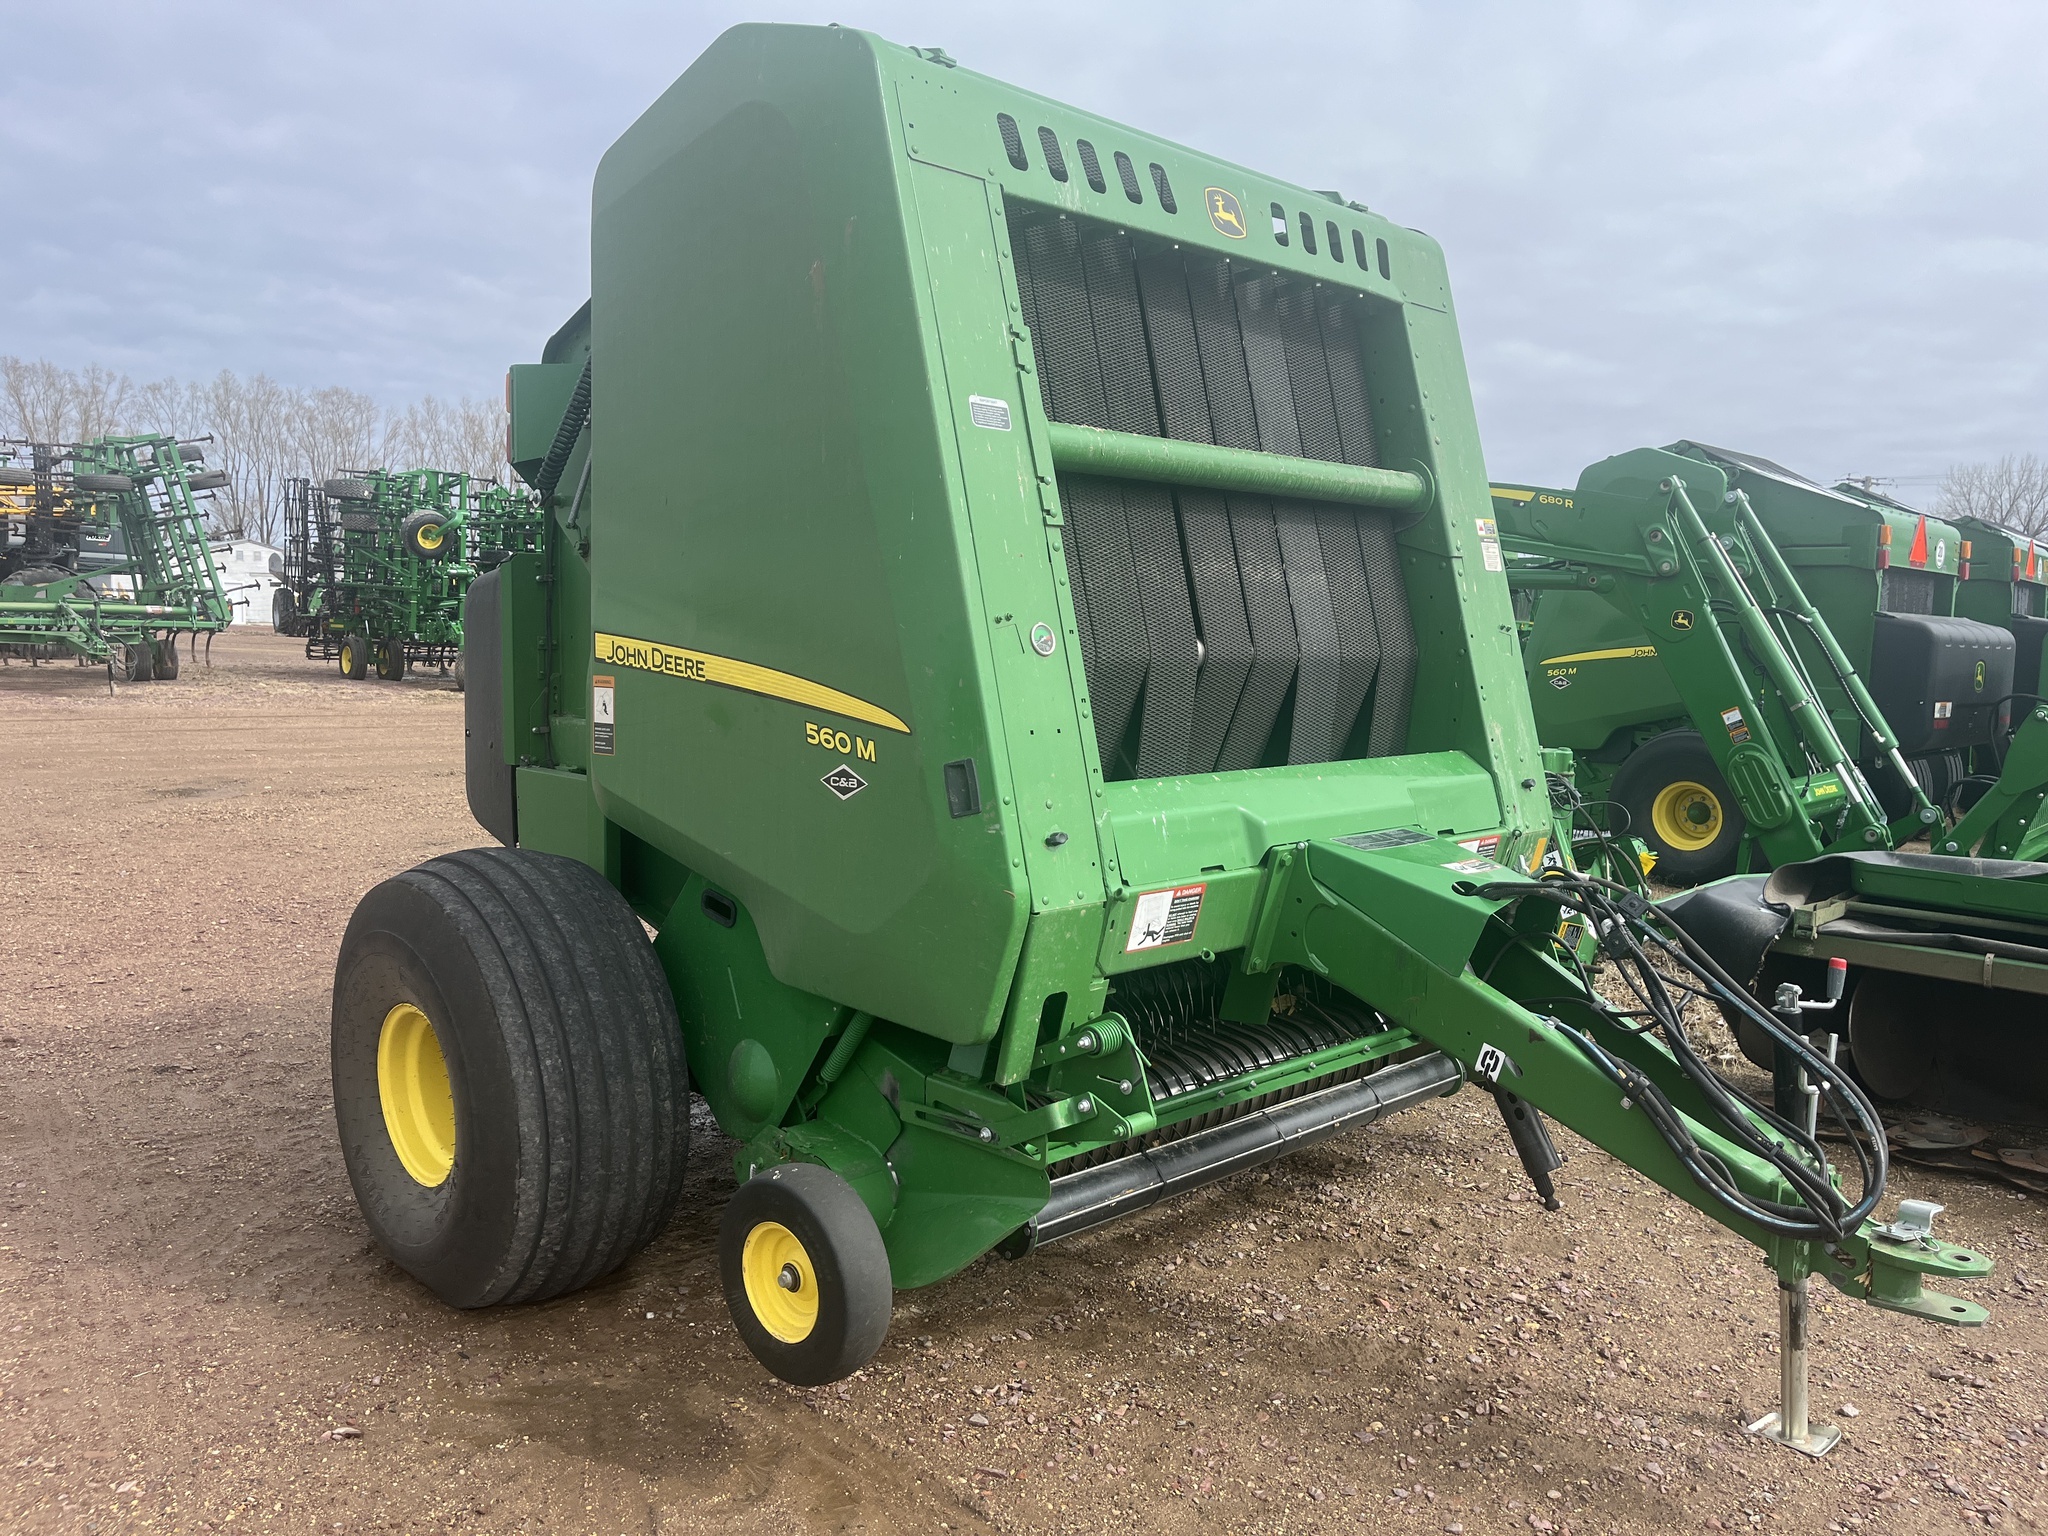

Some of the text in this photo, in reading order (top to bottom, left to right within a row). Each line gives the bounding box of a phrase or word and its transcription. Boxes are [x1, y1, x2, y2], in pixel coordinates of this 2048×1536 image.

[1539, 494, 1573, 509] 680 R
[606, 640, 706, 679] JOHN DEERE
[1547, 667, 1577, 677] 560 M
[805, 721, 876, 763] 560 M
[830, 776, 858, 788] C&B
[1181, 886, 1202, 896] DANGER
